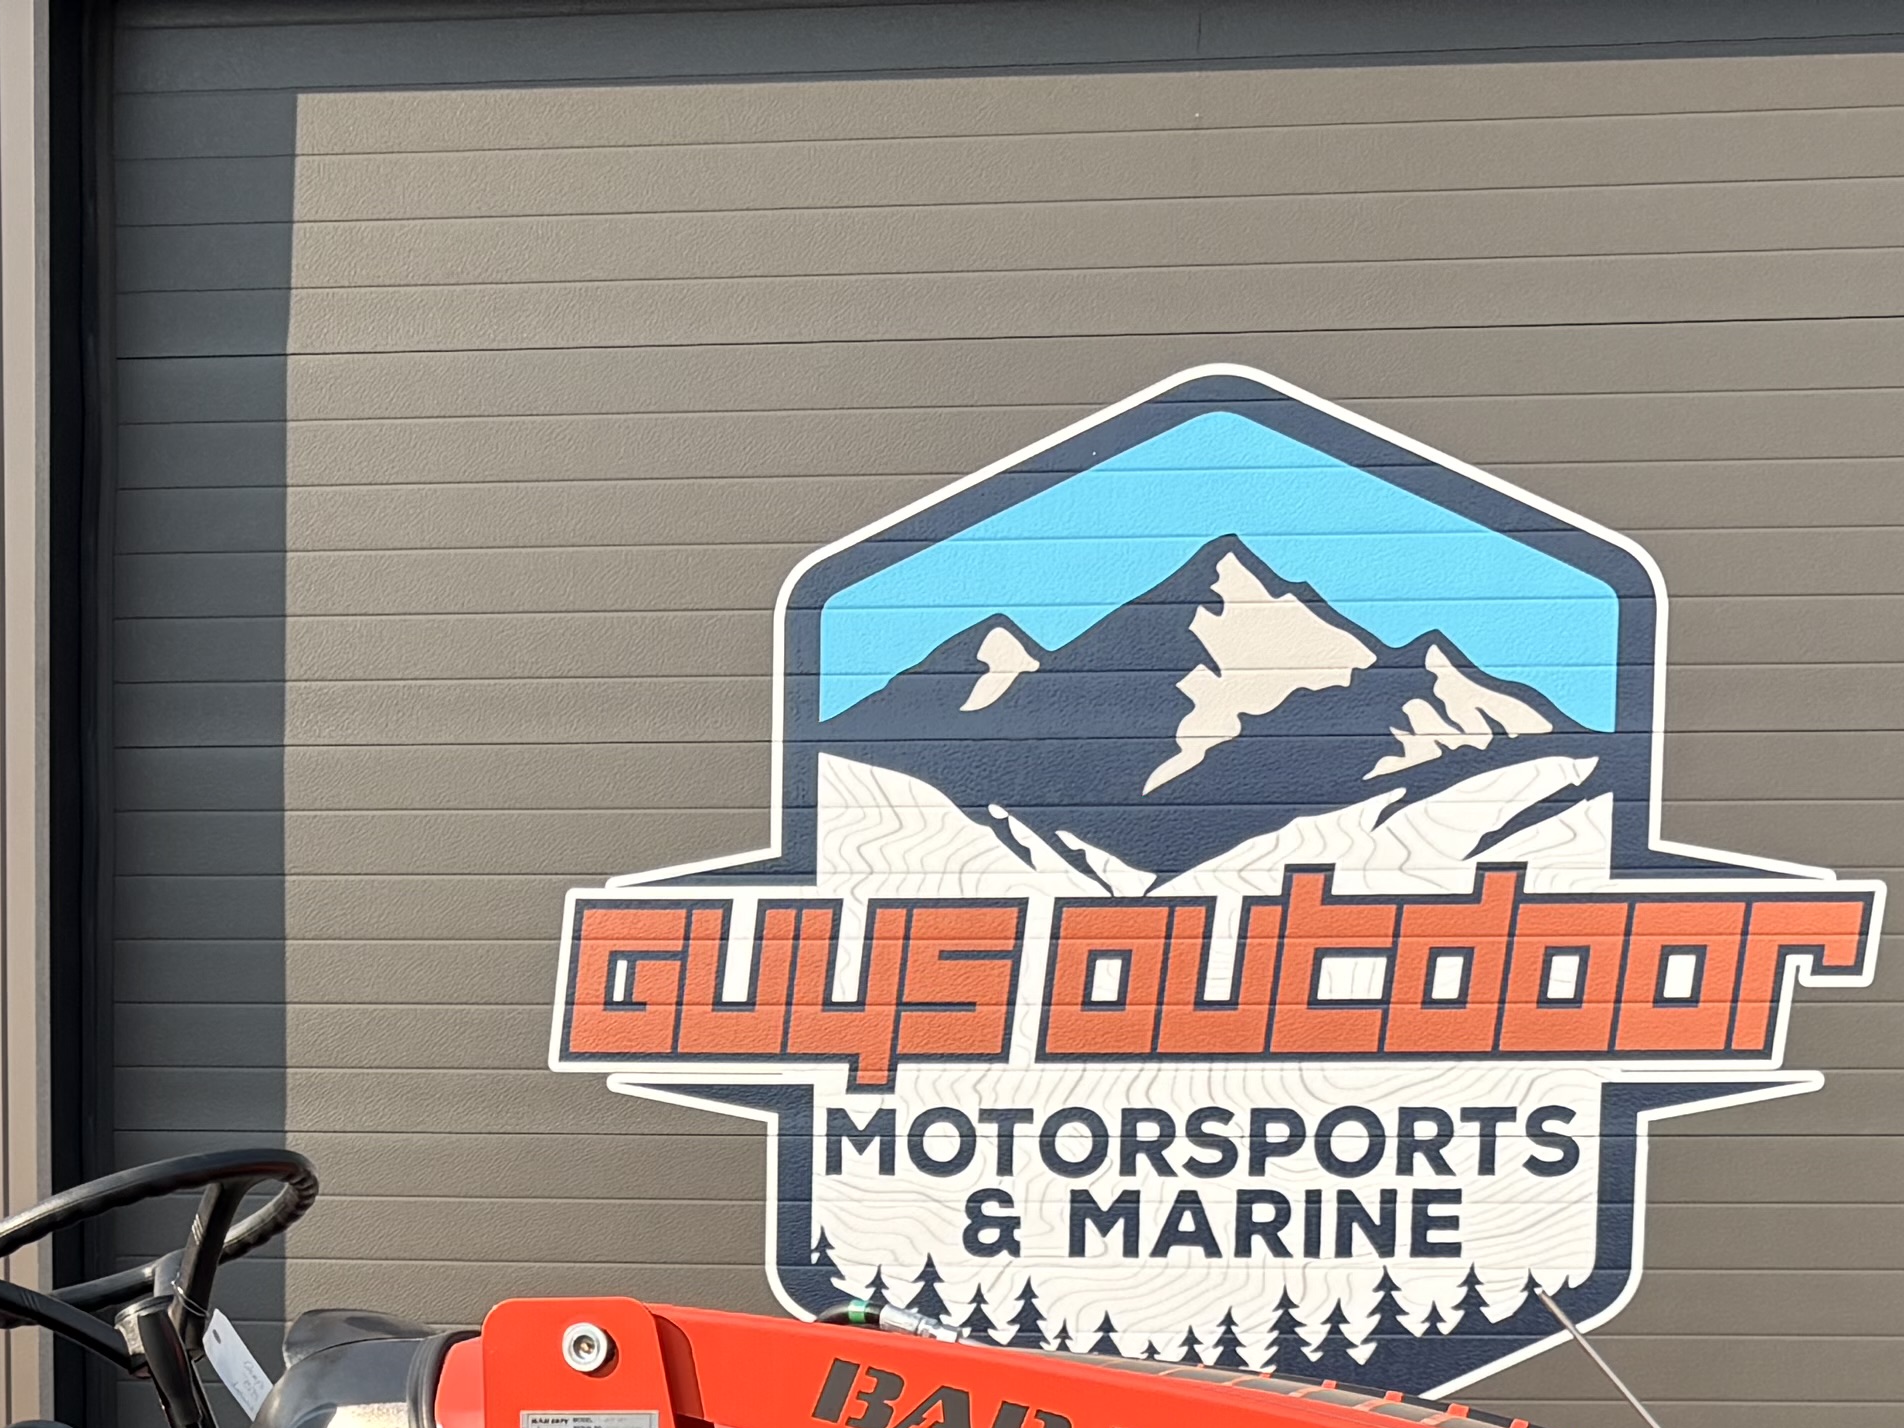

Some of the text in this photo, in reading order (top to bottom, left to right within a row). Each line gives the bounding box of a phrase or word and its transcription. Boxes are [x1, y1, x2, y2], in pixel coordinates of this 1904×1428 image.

[825, 1105, 1580, 1177] MOTORSPORTS
[962, 1189, 1464, 1258] & MARINE
